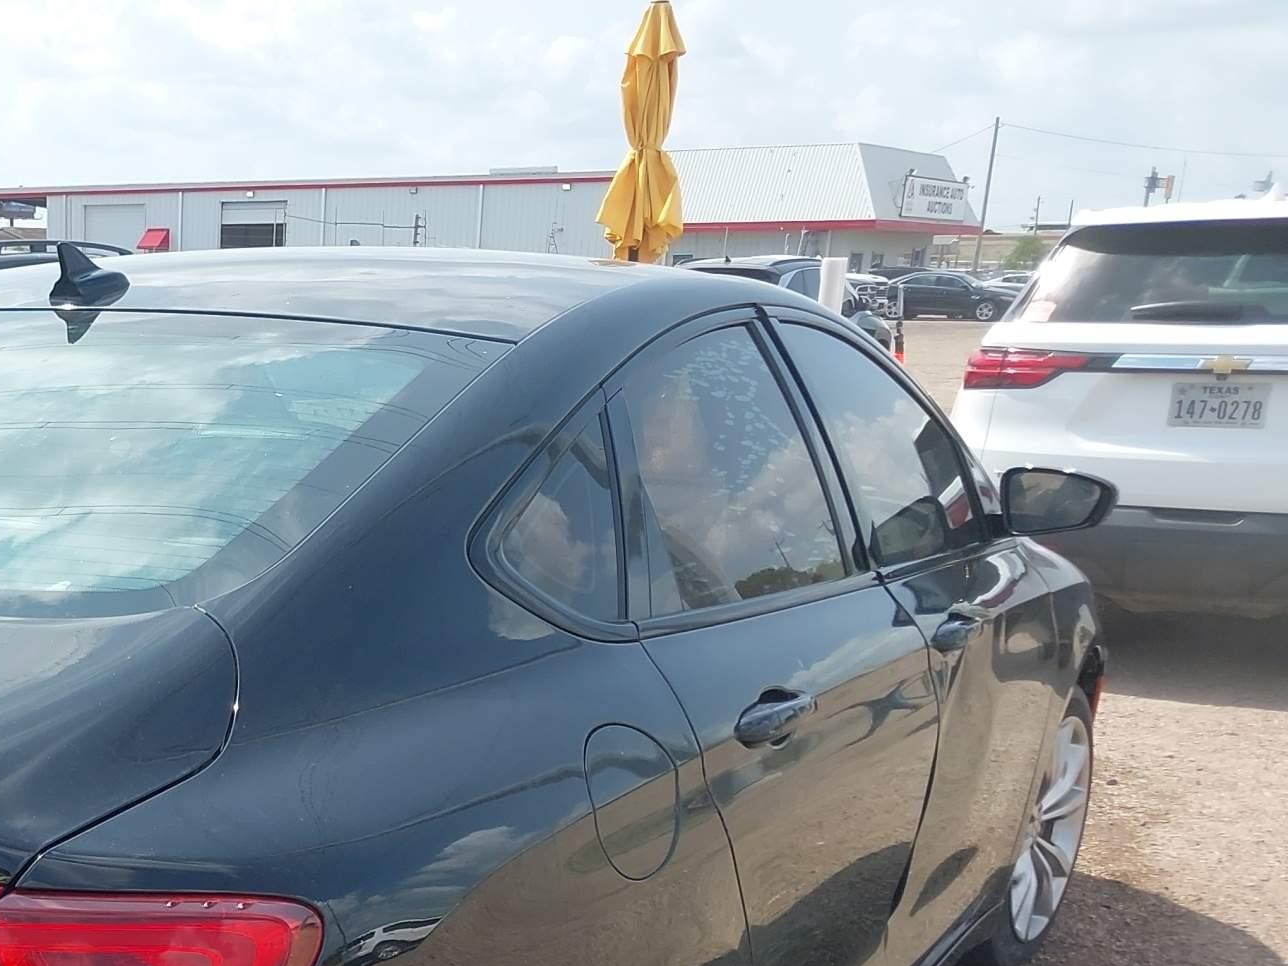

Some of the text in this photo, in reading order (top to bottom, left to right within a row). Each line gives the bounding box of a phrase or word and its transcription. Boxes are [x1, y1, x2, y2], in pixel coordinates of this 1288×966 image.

[919, 183, 950, 199] INSURANCE
[951, 188, 964, 200] AUTO
[927, 201, 953, 215] AUCTIONS
[1202, 386, 1240, 395] TEXAS
